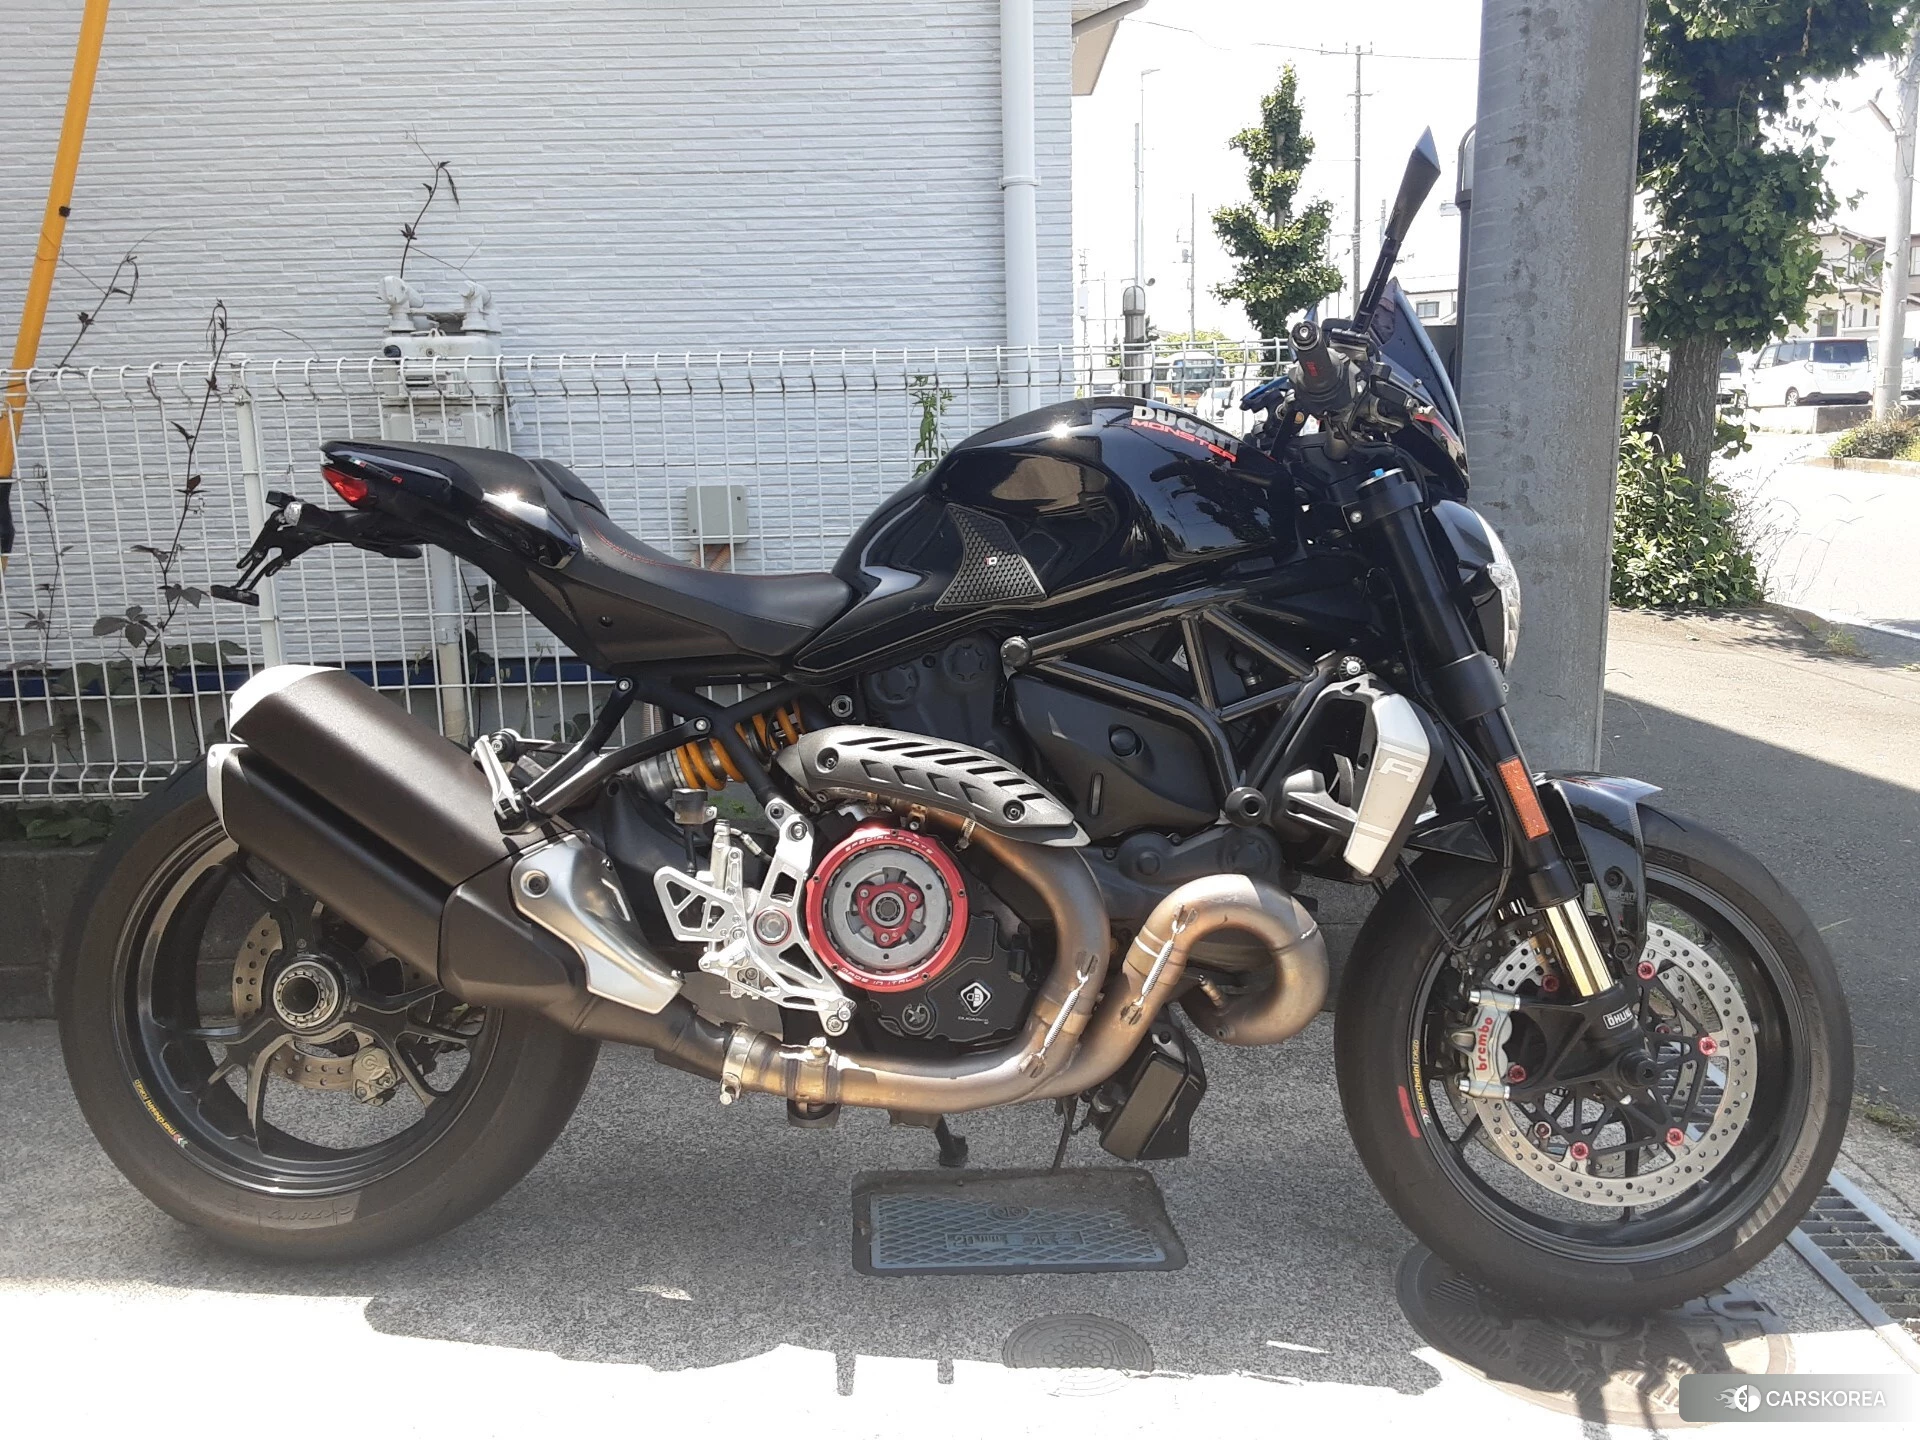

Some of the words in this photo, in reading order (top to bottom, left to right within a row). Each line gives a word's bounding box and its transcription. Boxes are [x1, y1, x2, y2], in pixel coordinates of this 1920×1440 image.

[1130, 419, 1237, 463] MONSTER
[1132, 405, 1239, 455] DUCATI
[845, 835, 891, 852] SPECIAL
[1476, 1016, 1493, 1071] brembo
[1412, 1063, 1426, 1108] marchesini
